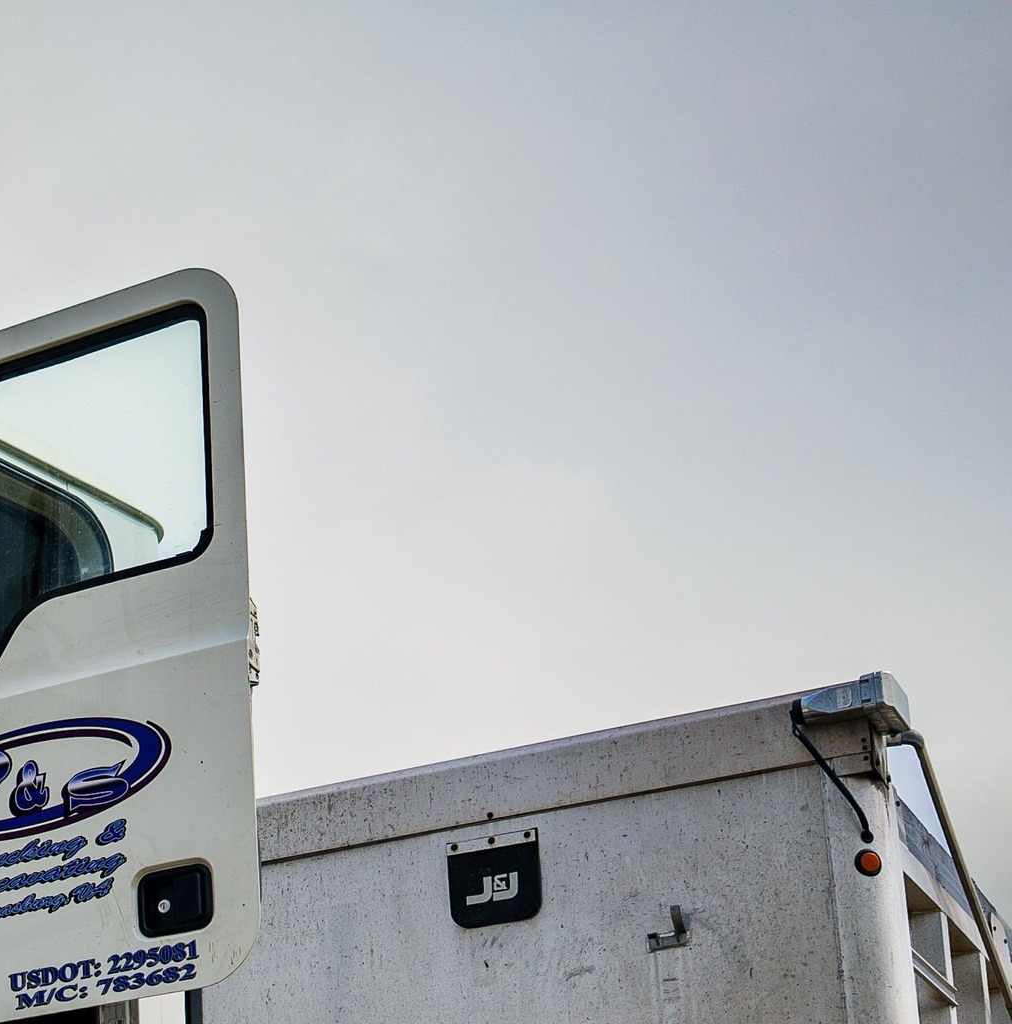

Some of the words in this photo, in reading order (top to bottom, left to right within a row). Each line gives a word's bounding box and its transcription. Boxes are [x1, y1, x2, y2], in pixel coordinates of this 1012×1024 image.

[9, 760, 50, 817] &
[62, 760, 129, 818] S
[95, 819, 127, 846] &
[69, 877, 114, 904] VA
[466, 871, 519, 906] J&J
[8, 958, 102, 992] USDOT:
[107, 939, 199, 975] 2295081
[15, 983, 88, 1010] M/C:
[96, 963, 197, 996] 783682
